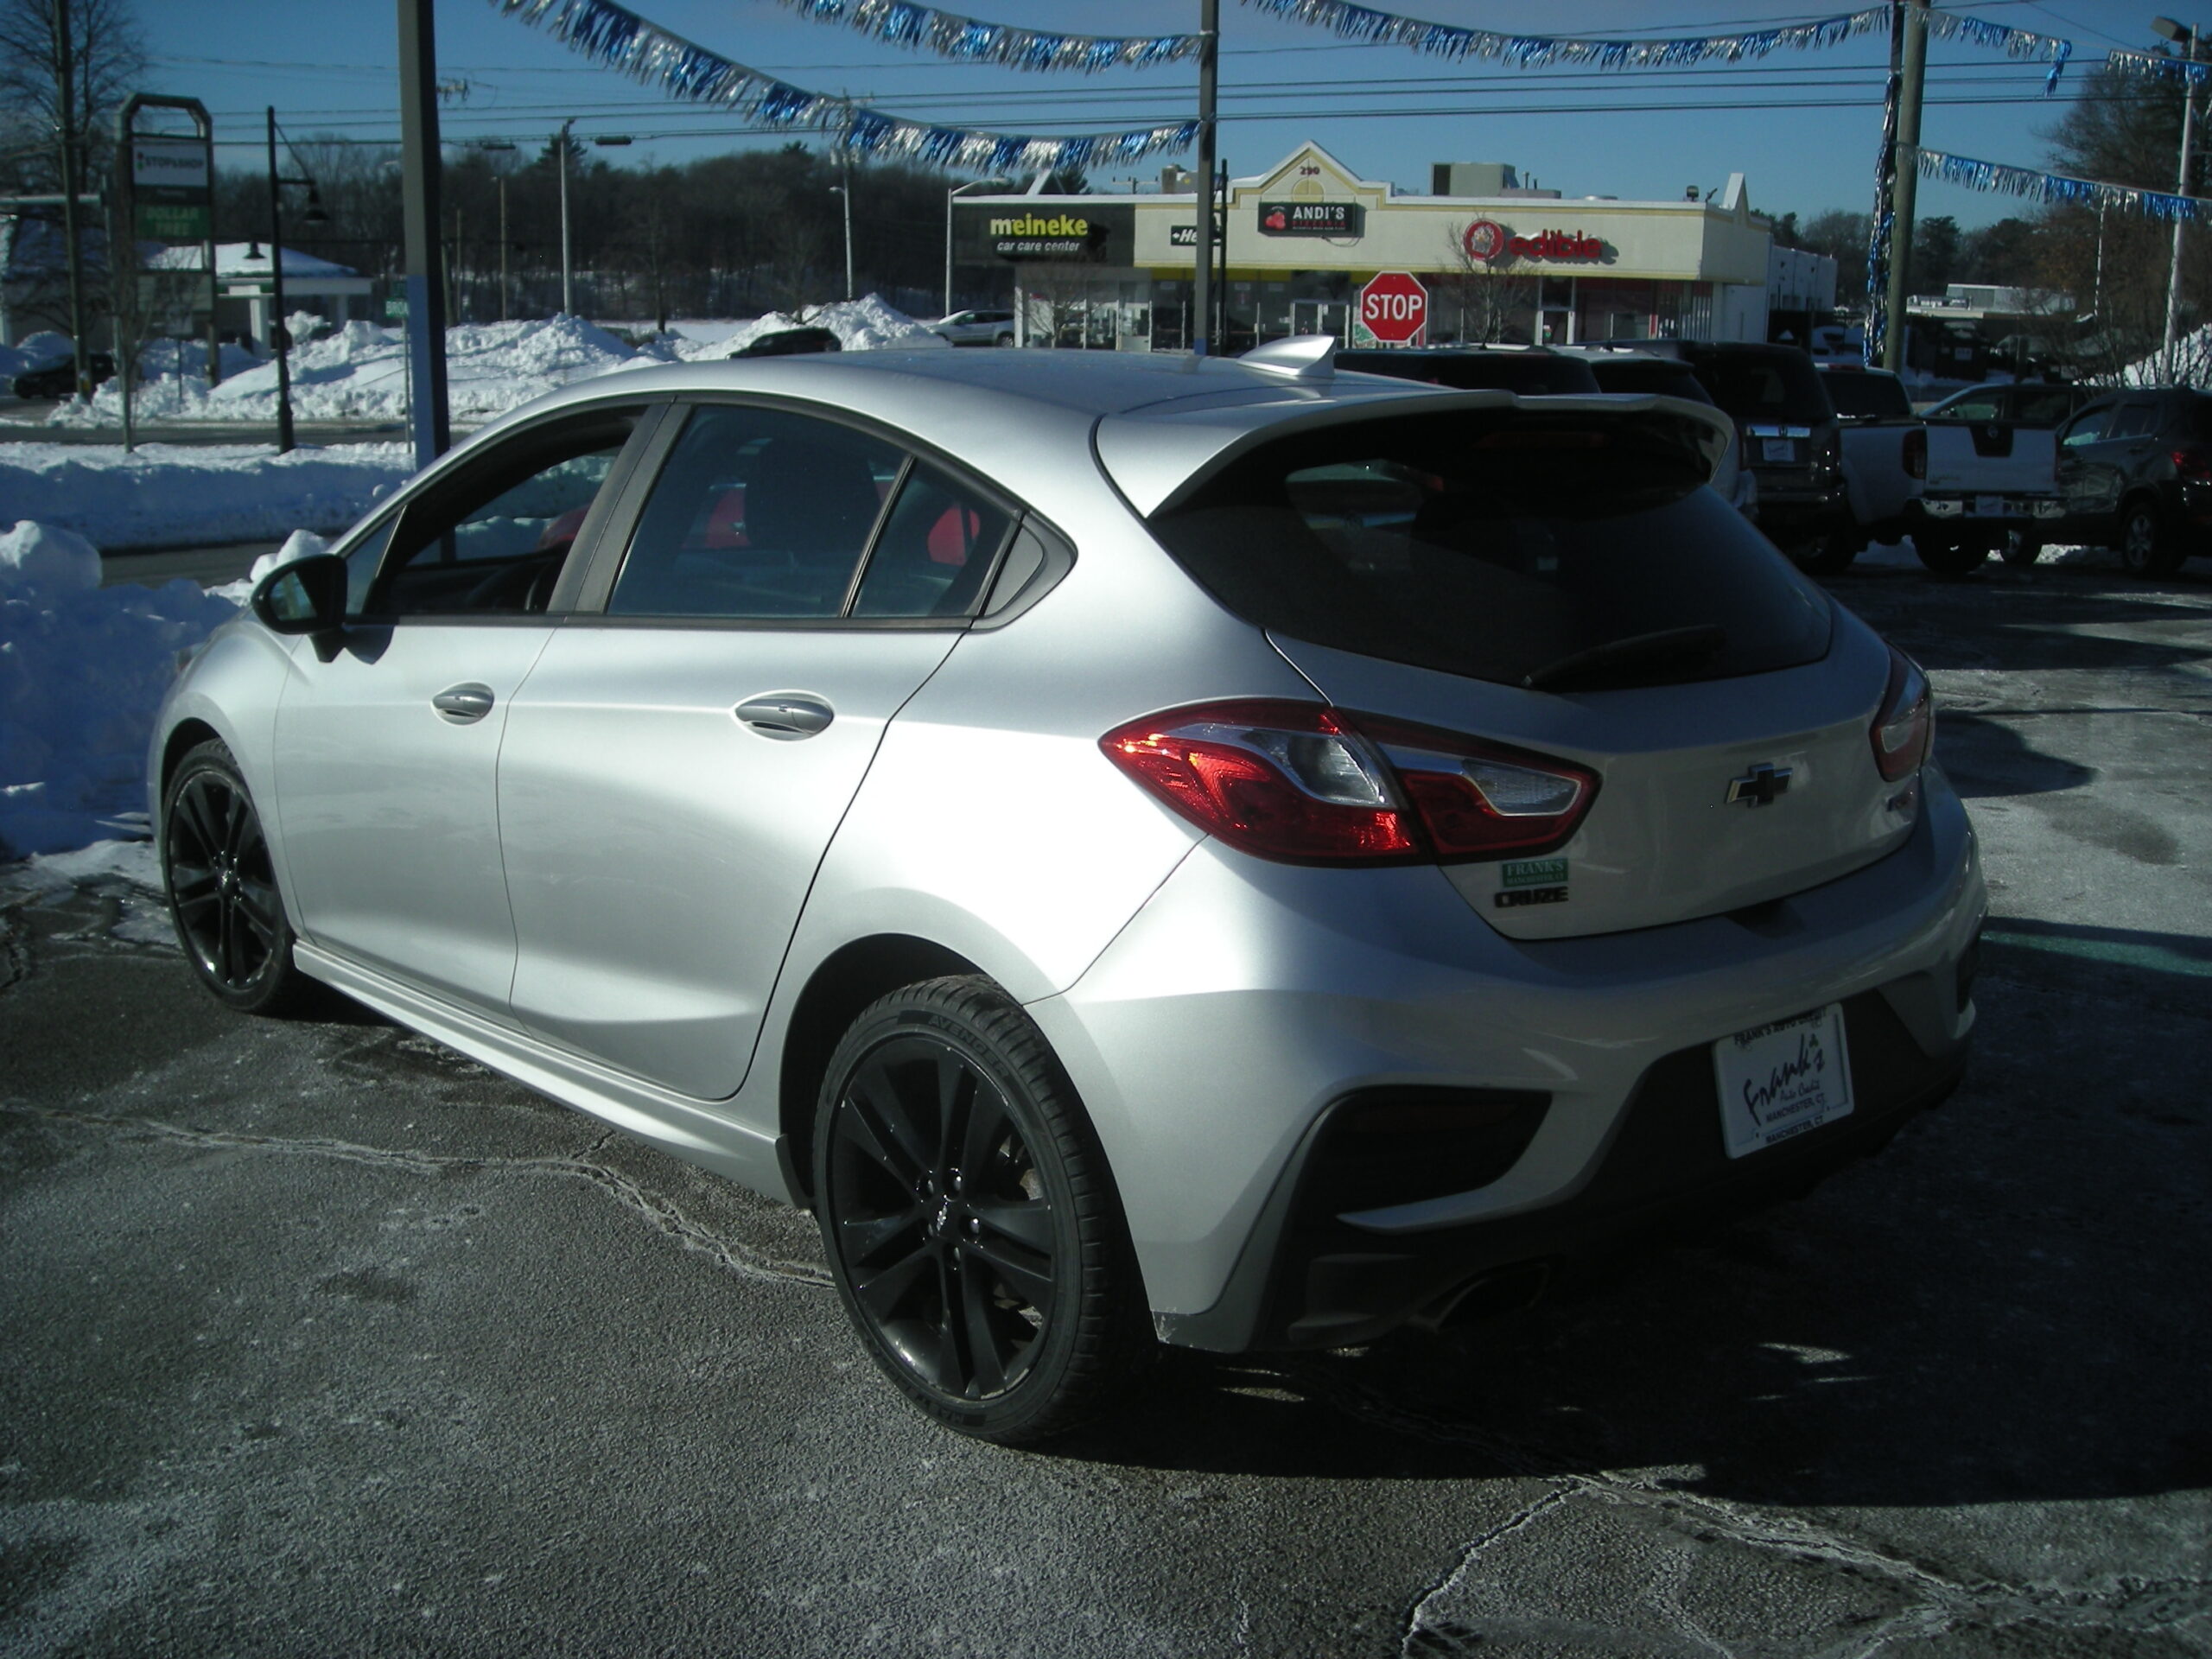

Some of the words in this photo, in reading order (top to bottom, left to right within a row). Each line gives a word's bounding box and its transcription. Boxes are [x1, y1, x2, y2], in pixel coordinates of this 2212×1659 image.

[1300, 167, 1320, 176] 290
[1293, 206, 1345, 219] ANDI'S
[990, 213, 1089, 236] meineke
[996, 241, 1015, 251] car
[1017, 241, 1042, 251] care
[1045, 240, 1081, 251] center
[1508, 229, 1602, 258] edible
[1365, 293, 1423, 321] STOP
[1494, 887, 1568, 908] CRUZE
[928, 1015, 1009, 1077] AVENGER
